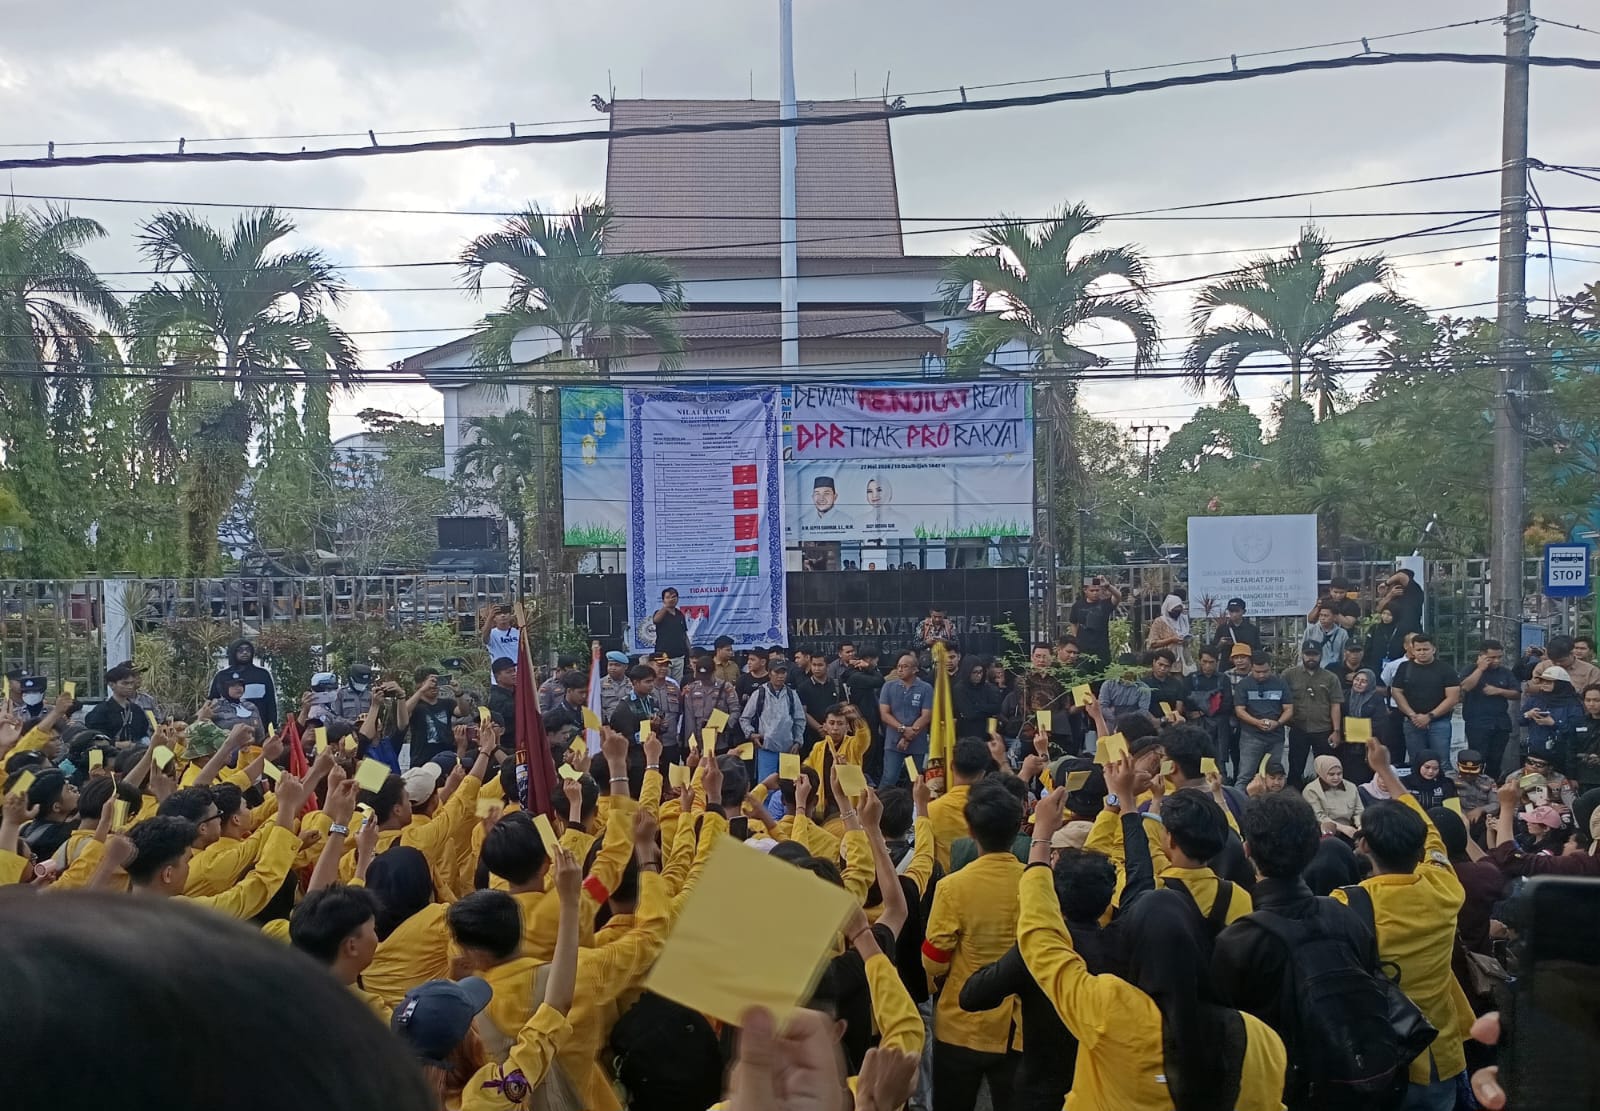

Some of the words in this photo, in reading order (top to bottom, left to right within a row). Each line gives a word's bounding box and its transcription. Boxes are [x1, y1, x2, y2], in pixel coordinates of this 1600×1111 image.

[794, 385, 856, 408] DEWAN
[973, 383, 1018, 410] REZIM
[797, 423, 845, 451] DPR
[843, 425, 902, 449] TIDAK
[906, 422, 949, 448] PRO
[954, 418, 1023, 448] RAKYAT
[1552, 570, 1582, 580] STOP
[853, 616, 918, 636] RAKYAT
